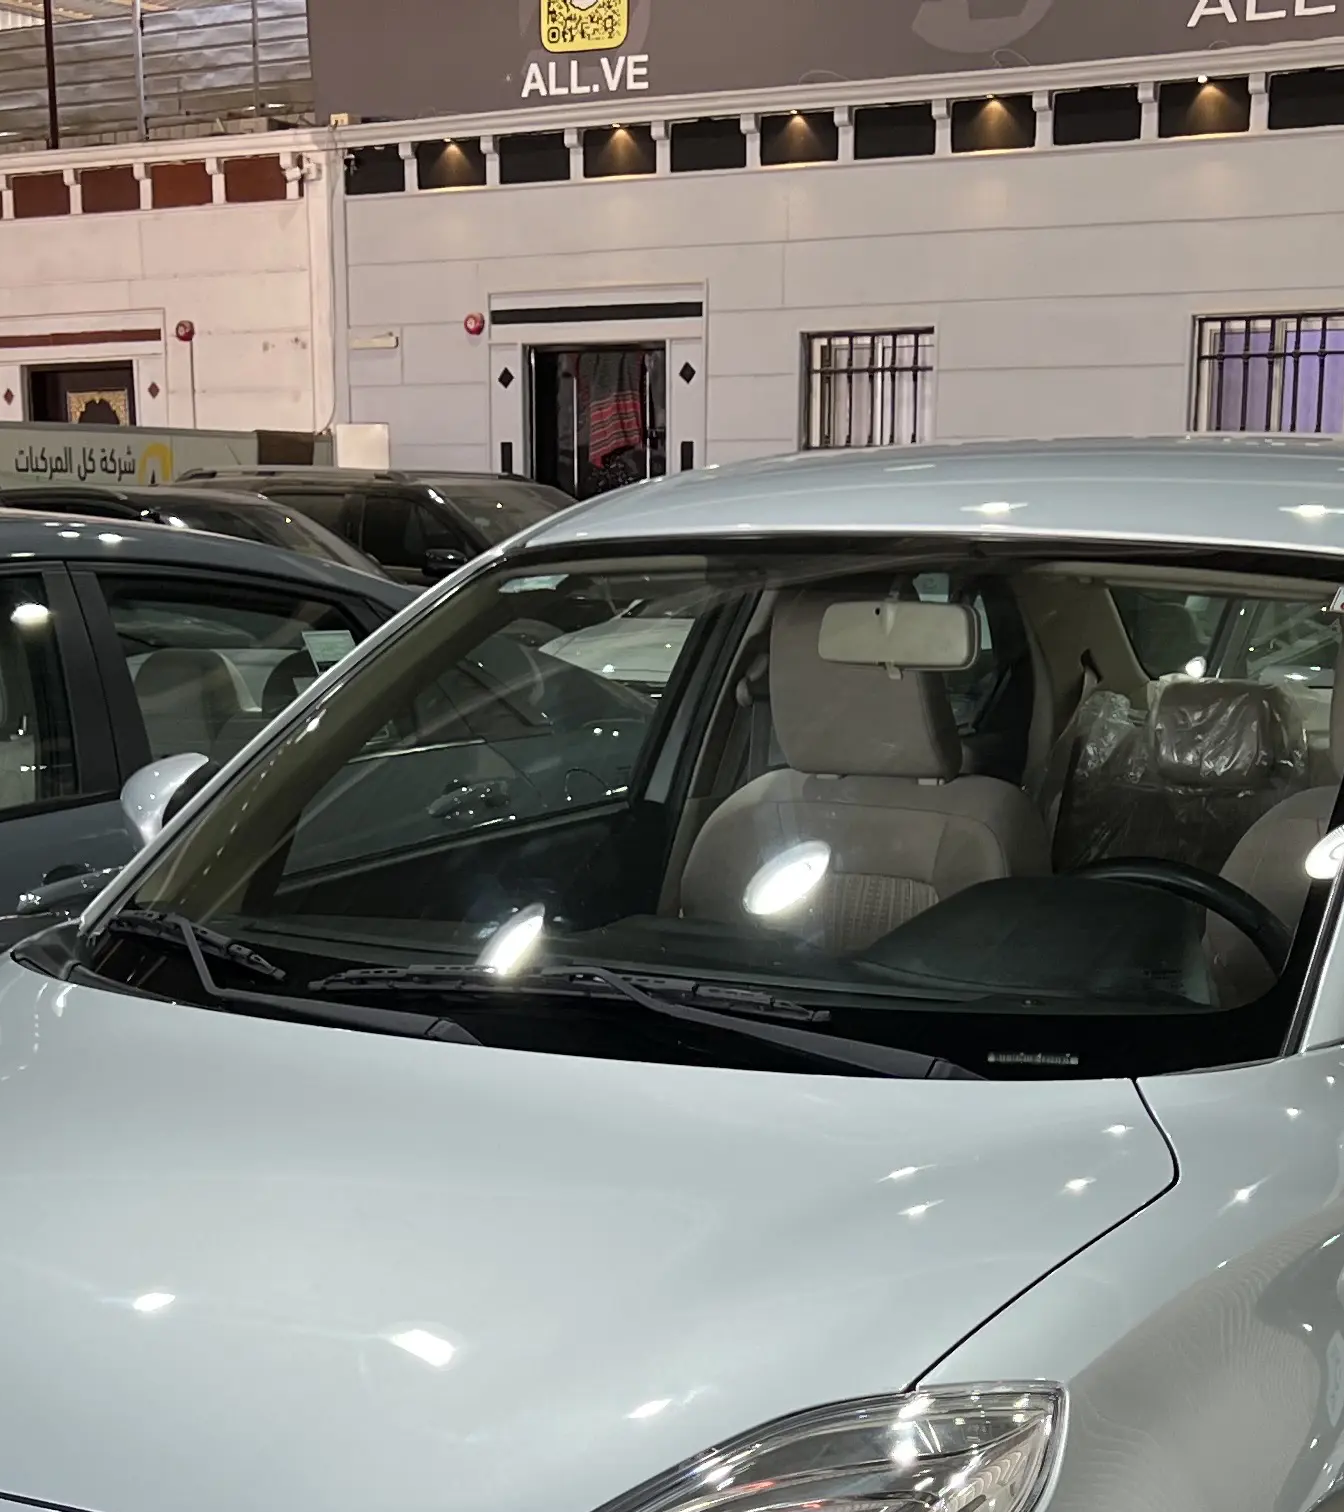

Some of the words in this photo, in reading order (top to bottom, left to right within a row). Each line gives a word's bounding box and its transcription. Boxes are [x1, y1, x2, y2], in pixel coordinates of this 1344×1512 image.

[521, 54, 649, 98] ALL.VE
[14, 445, 73, 481] المركبات
[77, 446, 96, 482] كل
[99, 445, 136, 482] شركة
